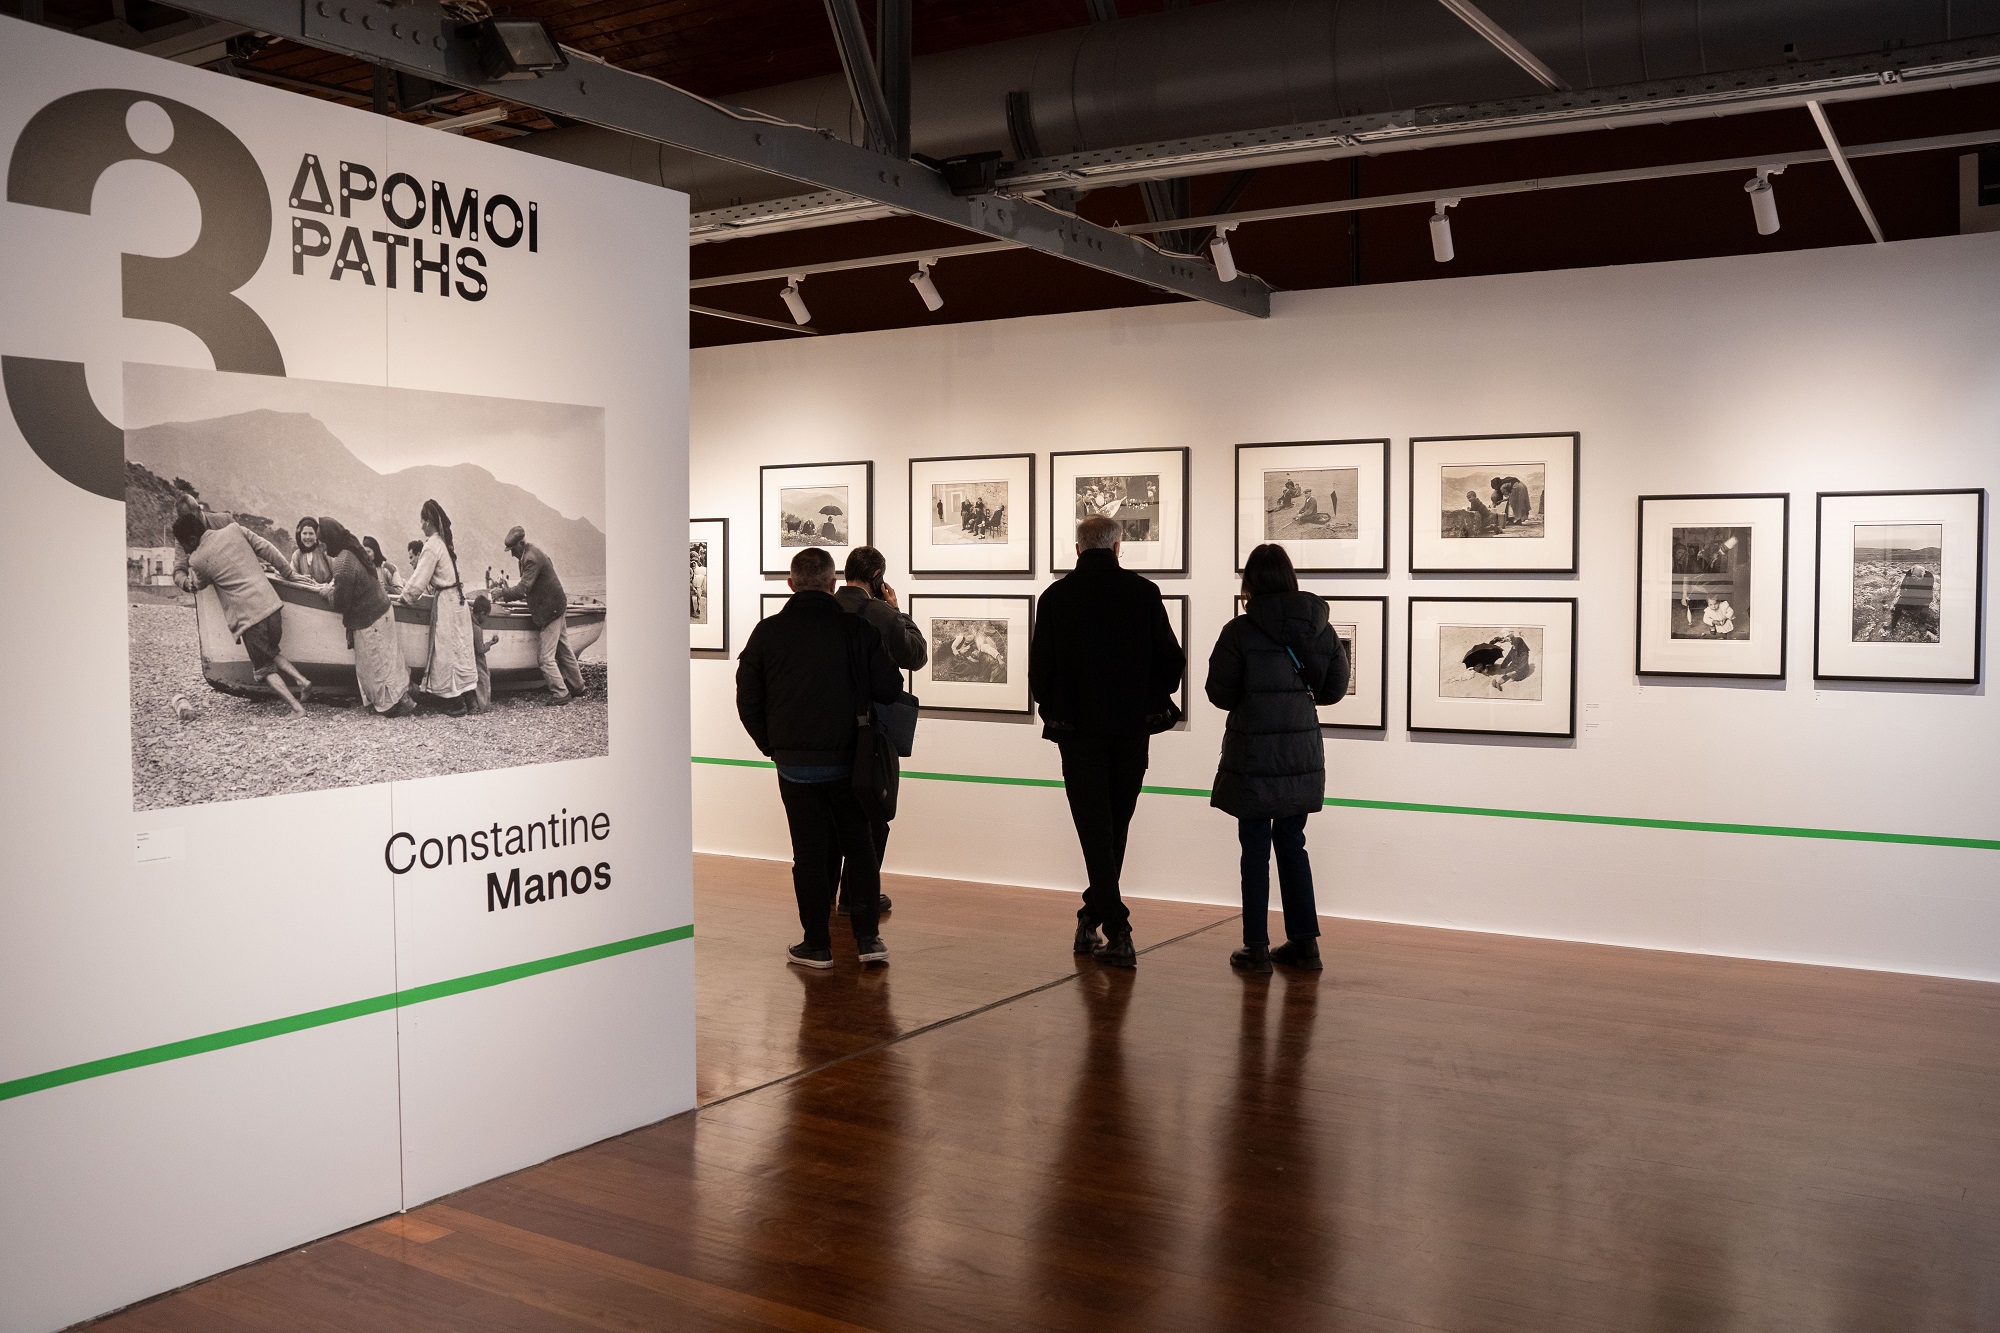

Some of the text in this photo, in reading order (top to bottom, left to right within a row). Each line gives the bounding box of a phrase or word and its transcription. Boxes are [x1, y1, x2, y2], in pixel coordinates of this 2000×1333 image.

[1, 88, 286, 502] 3
[292, 216, 488, 302] PATHS
[385, 808, 611, 874] Constantine
[487, 862, 611, 912] Manos
